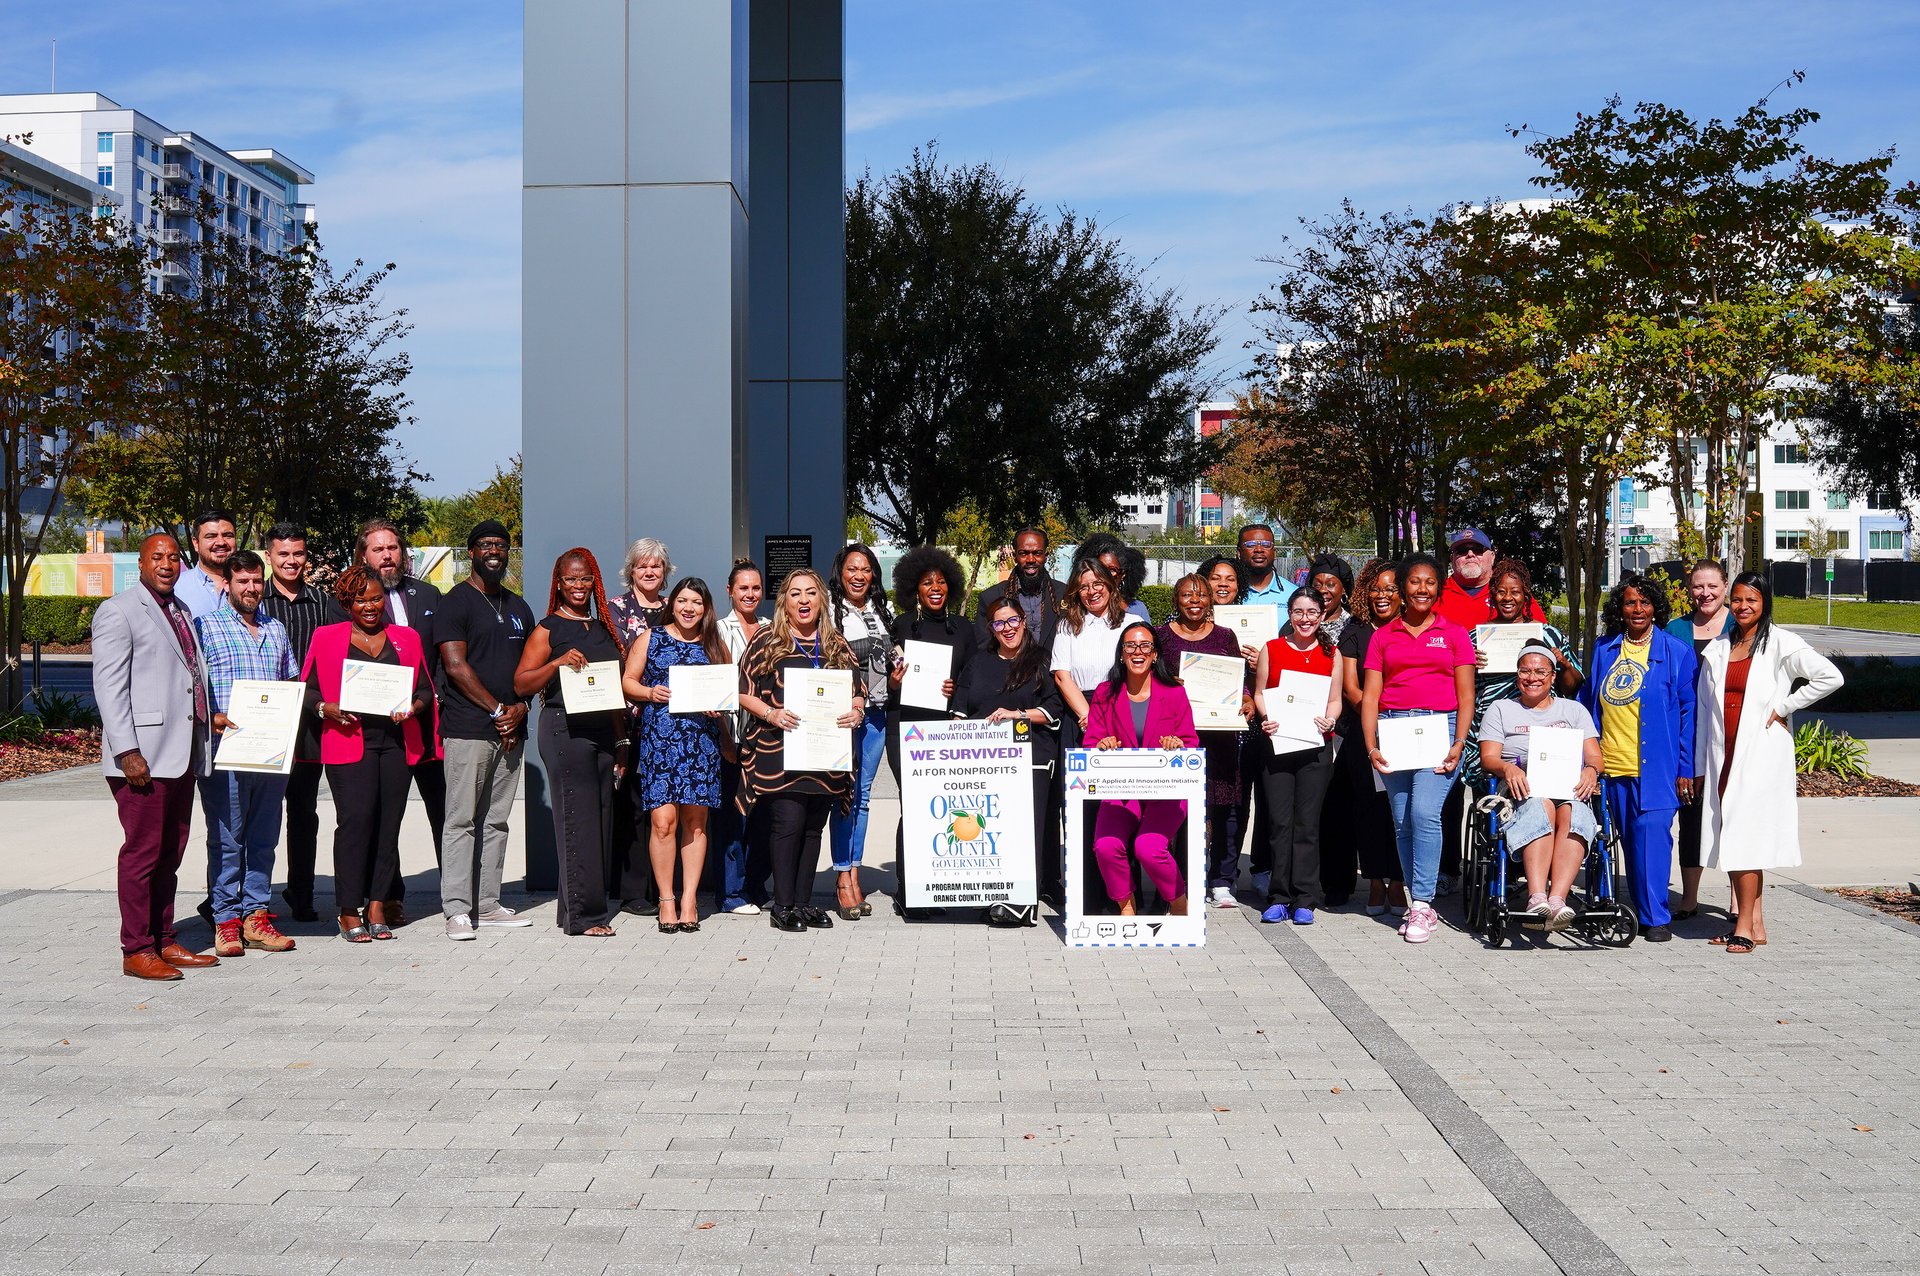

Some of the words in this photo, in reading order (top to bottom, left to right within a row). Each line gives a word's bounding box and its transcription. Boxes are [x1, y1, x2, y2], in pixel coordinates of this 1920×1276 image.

[948, 723, 977, 731] APPLIED
[928, 732, 972, 740] INNOVATION
[910, 750, 935, 761] WE
[939, 747, 1022, 760] SURVIVED!
[949, 766, 1017, 775] NONPROFITS
[944, 782, 986, 790] COURSE
[930, 794, 1000, 820] ORANGE
[933, 832, 1002, 856] COUNTY
[932, 858, 1002, 868] GOVERNMENT
[932, 883, 961, 891] PROGRAM
[958, 894, 983, 902] COUNTY,
